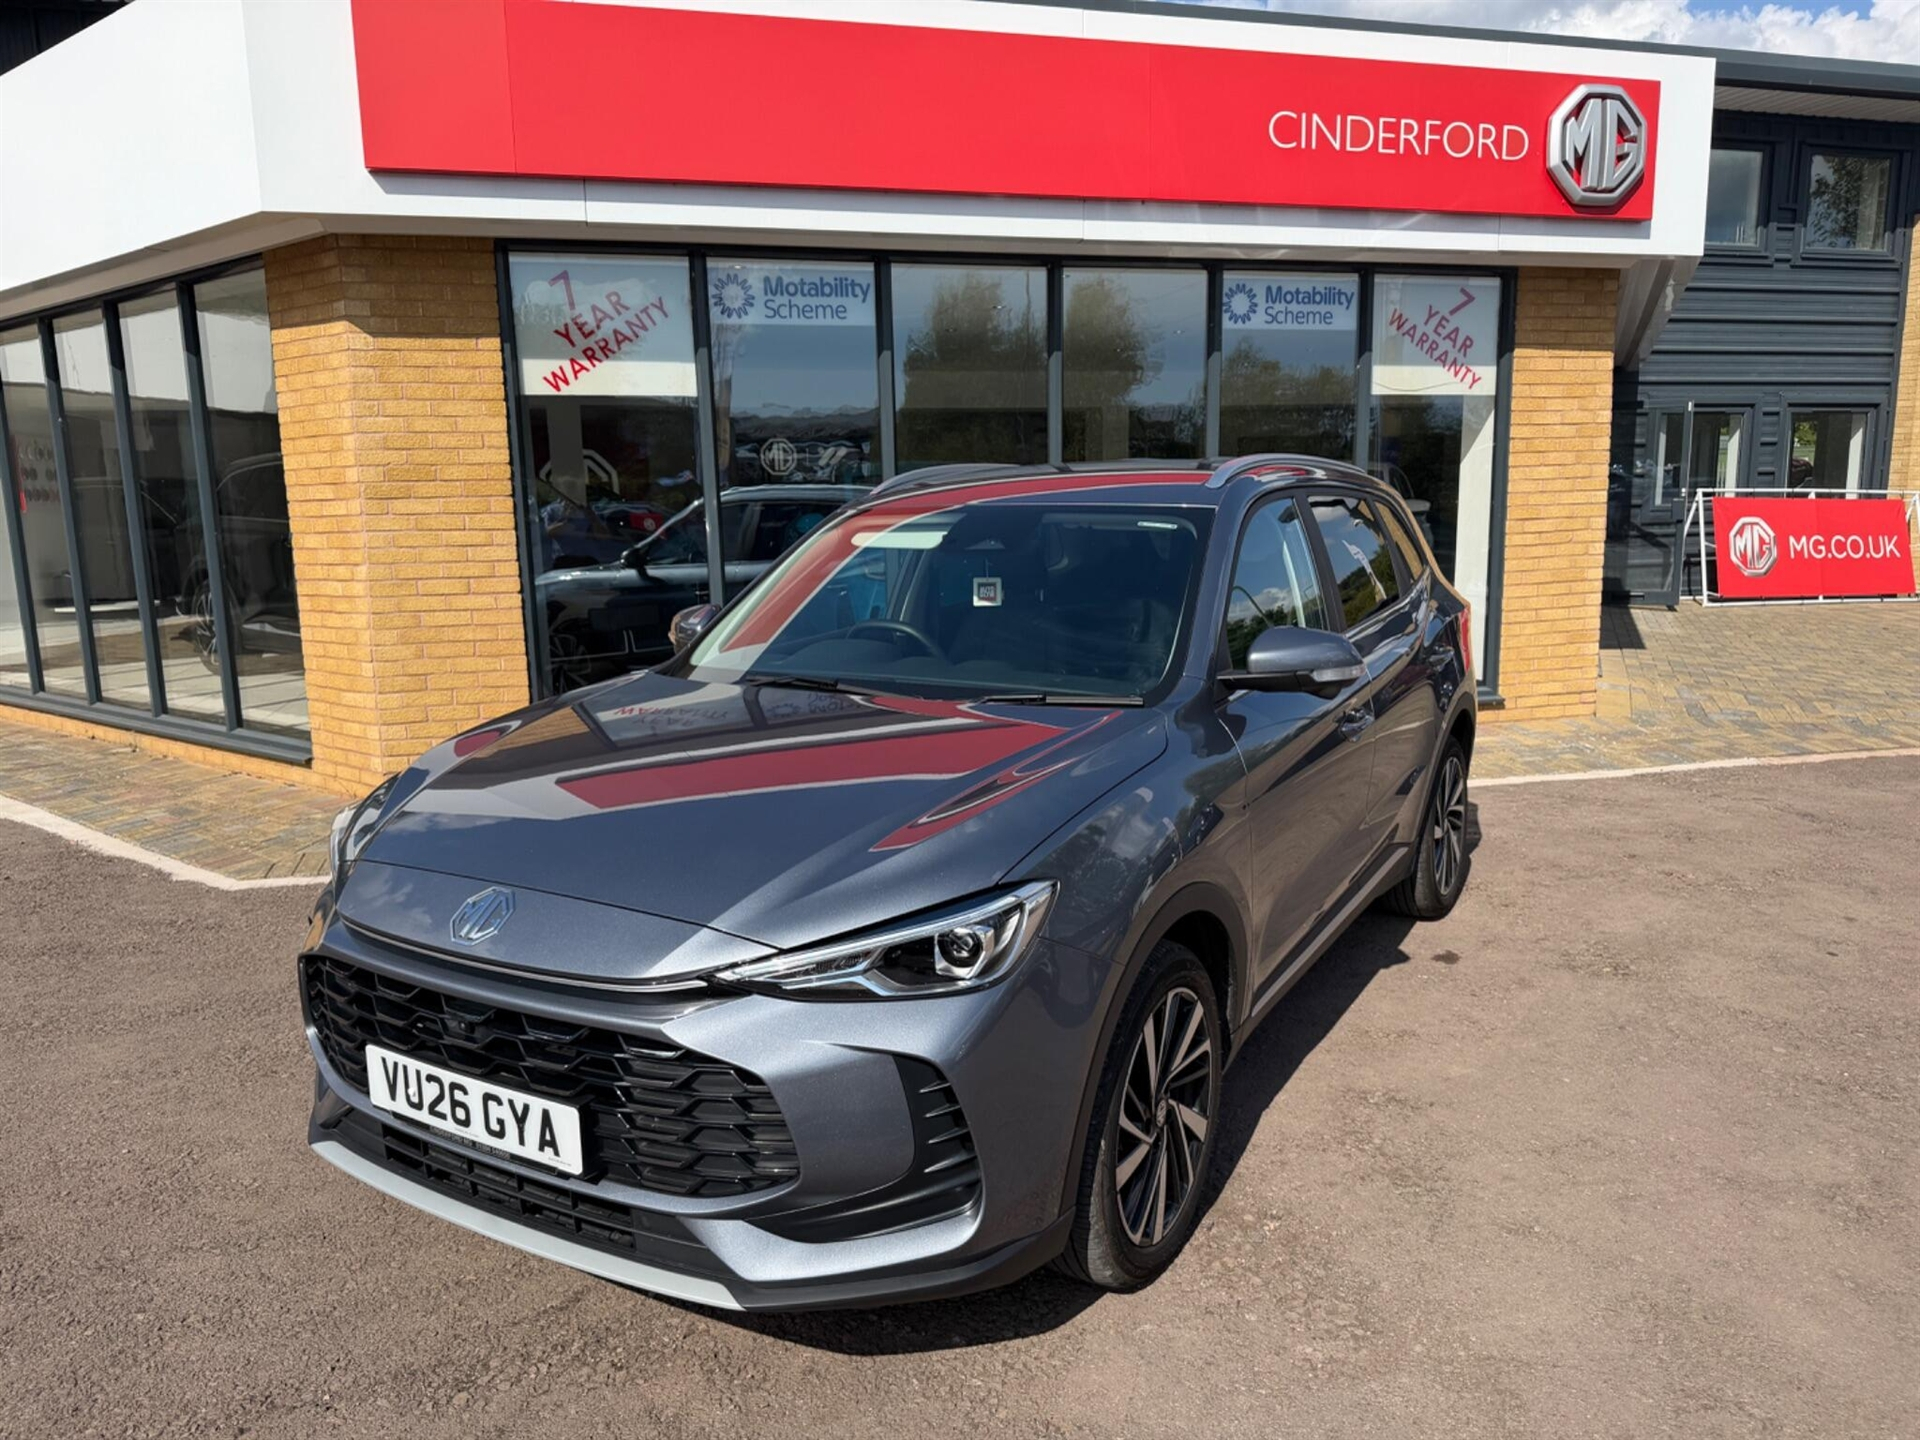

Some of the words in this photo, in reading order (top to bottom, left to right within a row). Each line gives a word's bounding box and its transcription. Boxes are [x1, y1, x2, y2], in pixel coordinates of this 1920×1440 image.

[1268, 110, 1530, 161] CINDERFORD
[548, 269, 576, 311] 7
[762, 274, 871, 303] Motability
[764, 298, 848, 320] Scheme
[1264, 284, 1355, 311] Motability
[1448, 287, 1476, 316] 7
[553, 290, 631, 349] YEAR
[1264, 305, 1334, 326] Scheme
[1423, 303, 1475, 359] YEAR
[542, 295, 669, 393] WARRANTY
[1388, 307, 1482, 390] WARRANTY
[1788, 534, 1901, 560] MG.CO.UK
[380, 1056, 472, 1129] VU26
[482, 1091, 561, 1158] GYA
